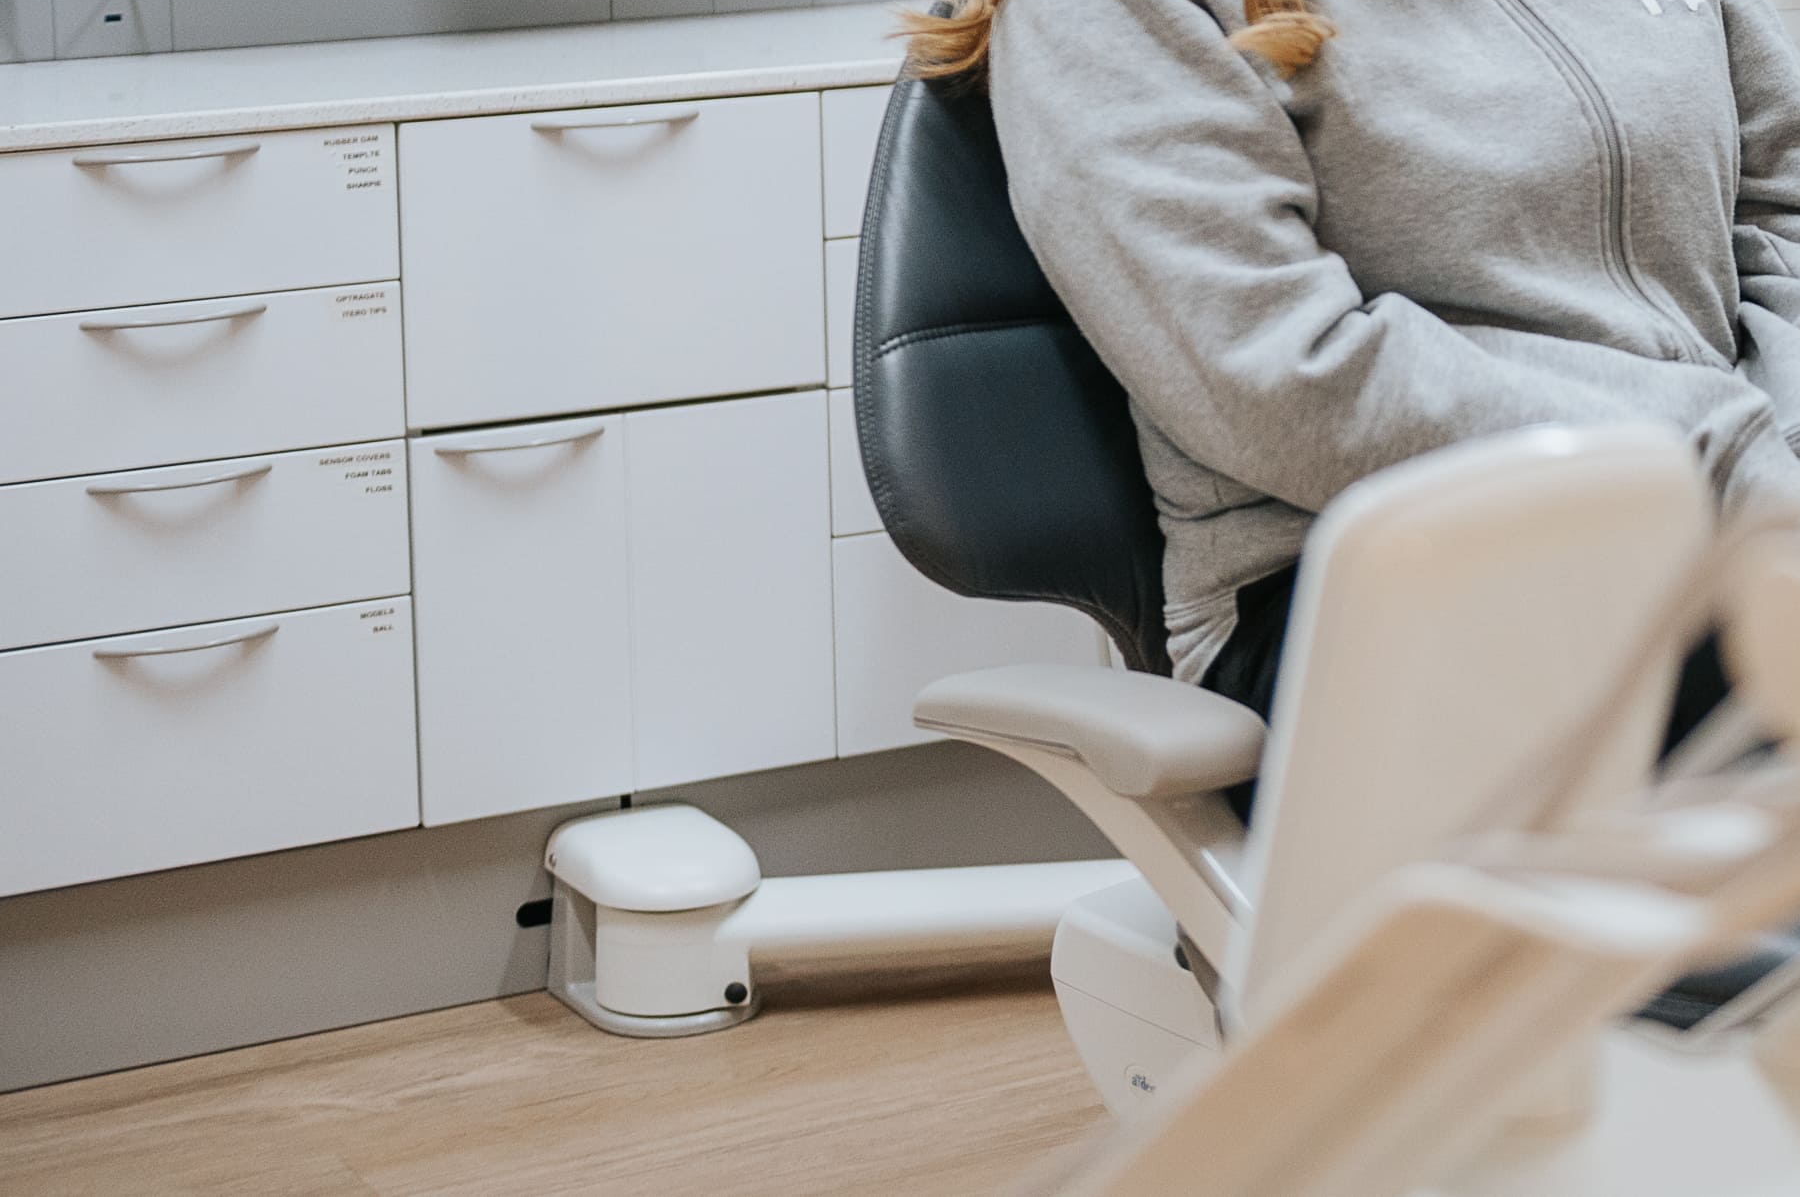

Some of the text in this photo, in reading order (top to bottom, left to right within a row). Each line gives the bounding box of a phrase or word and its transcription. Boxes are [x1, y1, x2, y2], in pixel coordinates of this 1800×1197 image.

[323, 137, 359, 146] RUBBER
[348, 166, 378, 175] PUNCH
[319, 452, 391, 466] SENSOR COVERS
[345, 471, 369, 479] FOAM
[365, 484, 393, 494] FLOSS
